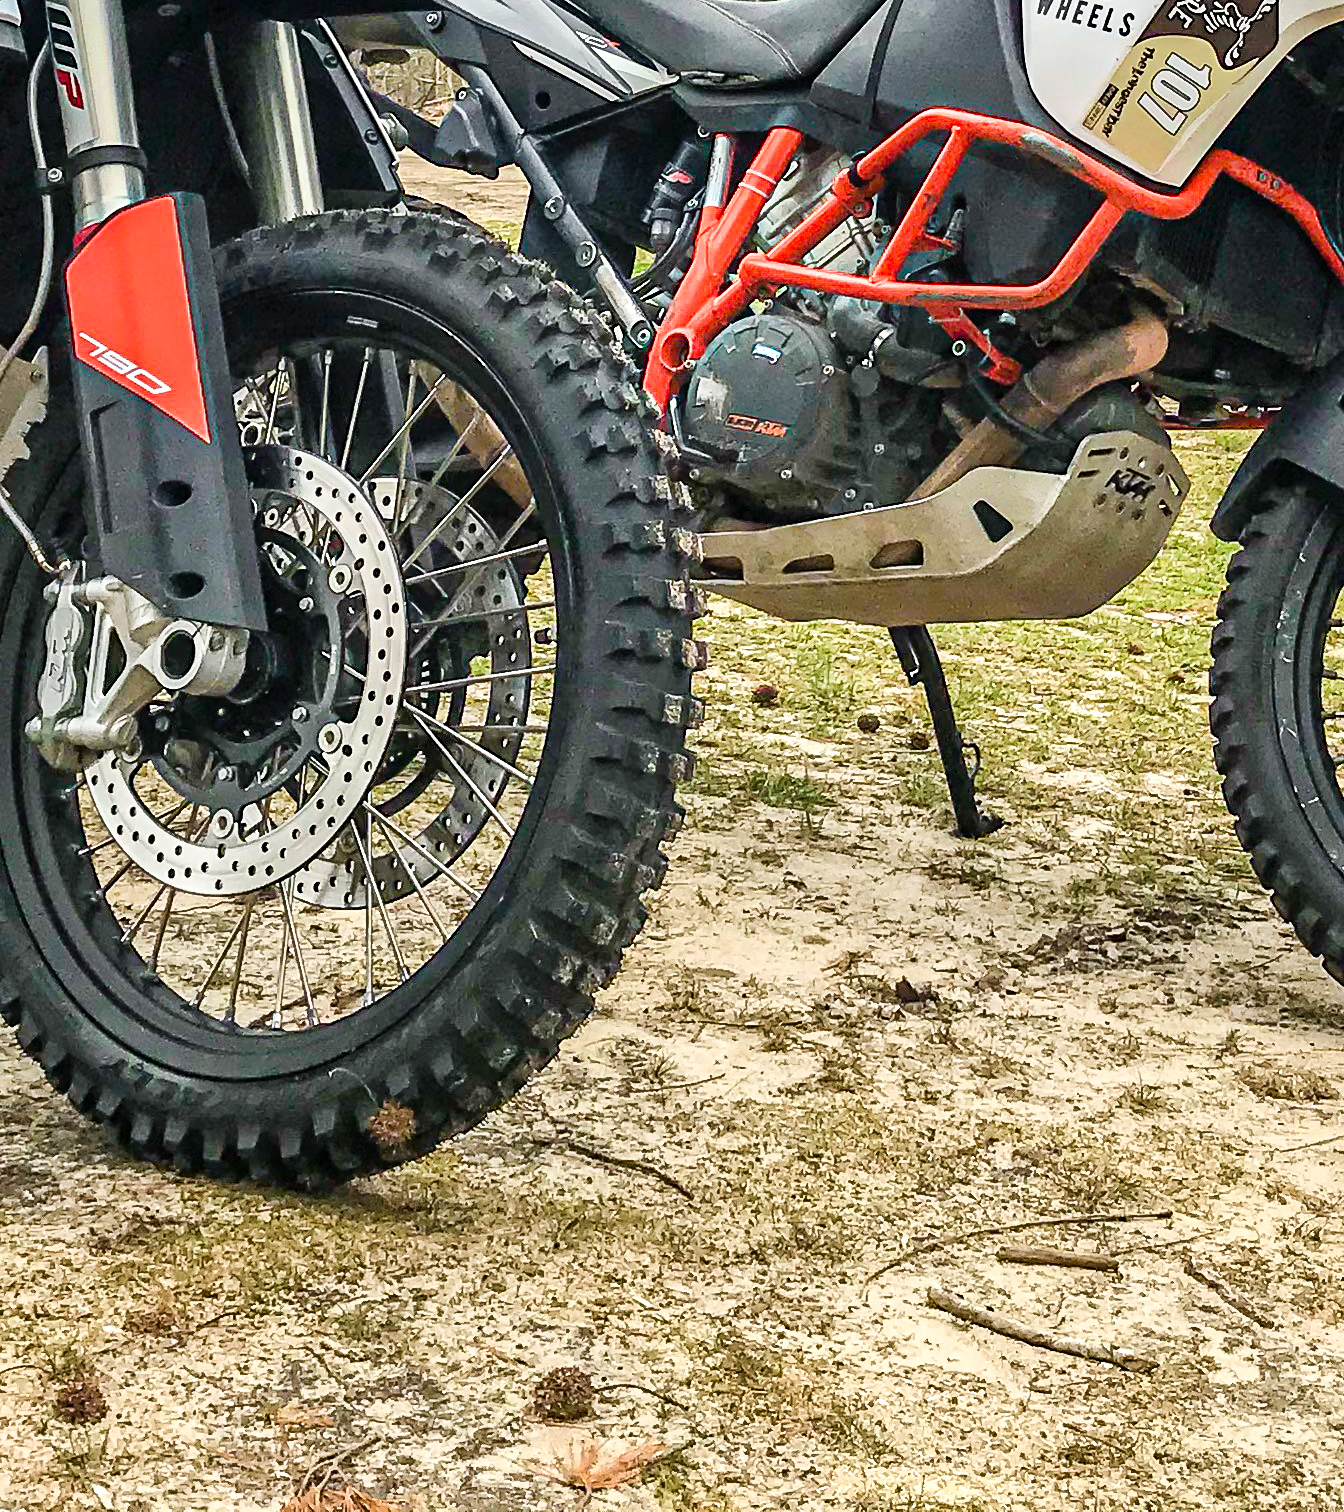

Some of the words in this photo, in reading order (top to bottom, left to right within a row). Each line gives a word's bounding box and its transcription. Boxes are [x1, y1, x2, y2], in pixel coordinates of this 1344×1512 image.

[46, 1, 84, 110] WP
[1137, 51, 1213, 136] 107
[79, 332, 172, 395] 790
[1104, 468, 1156, 503] KTM
